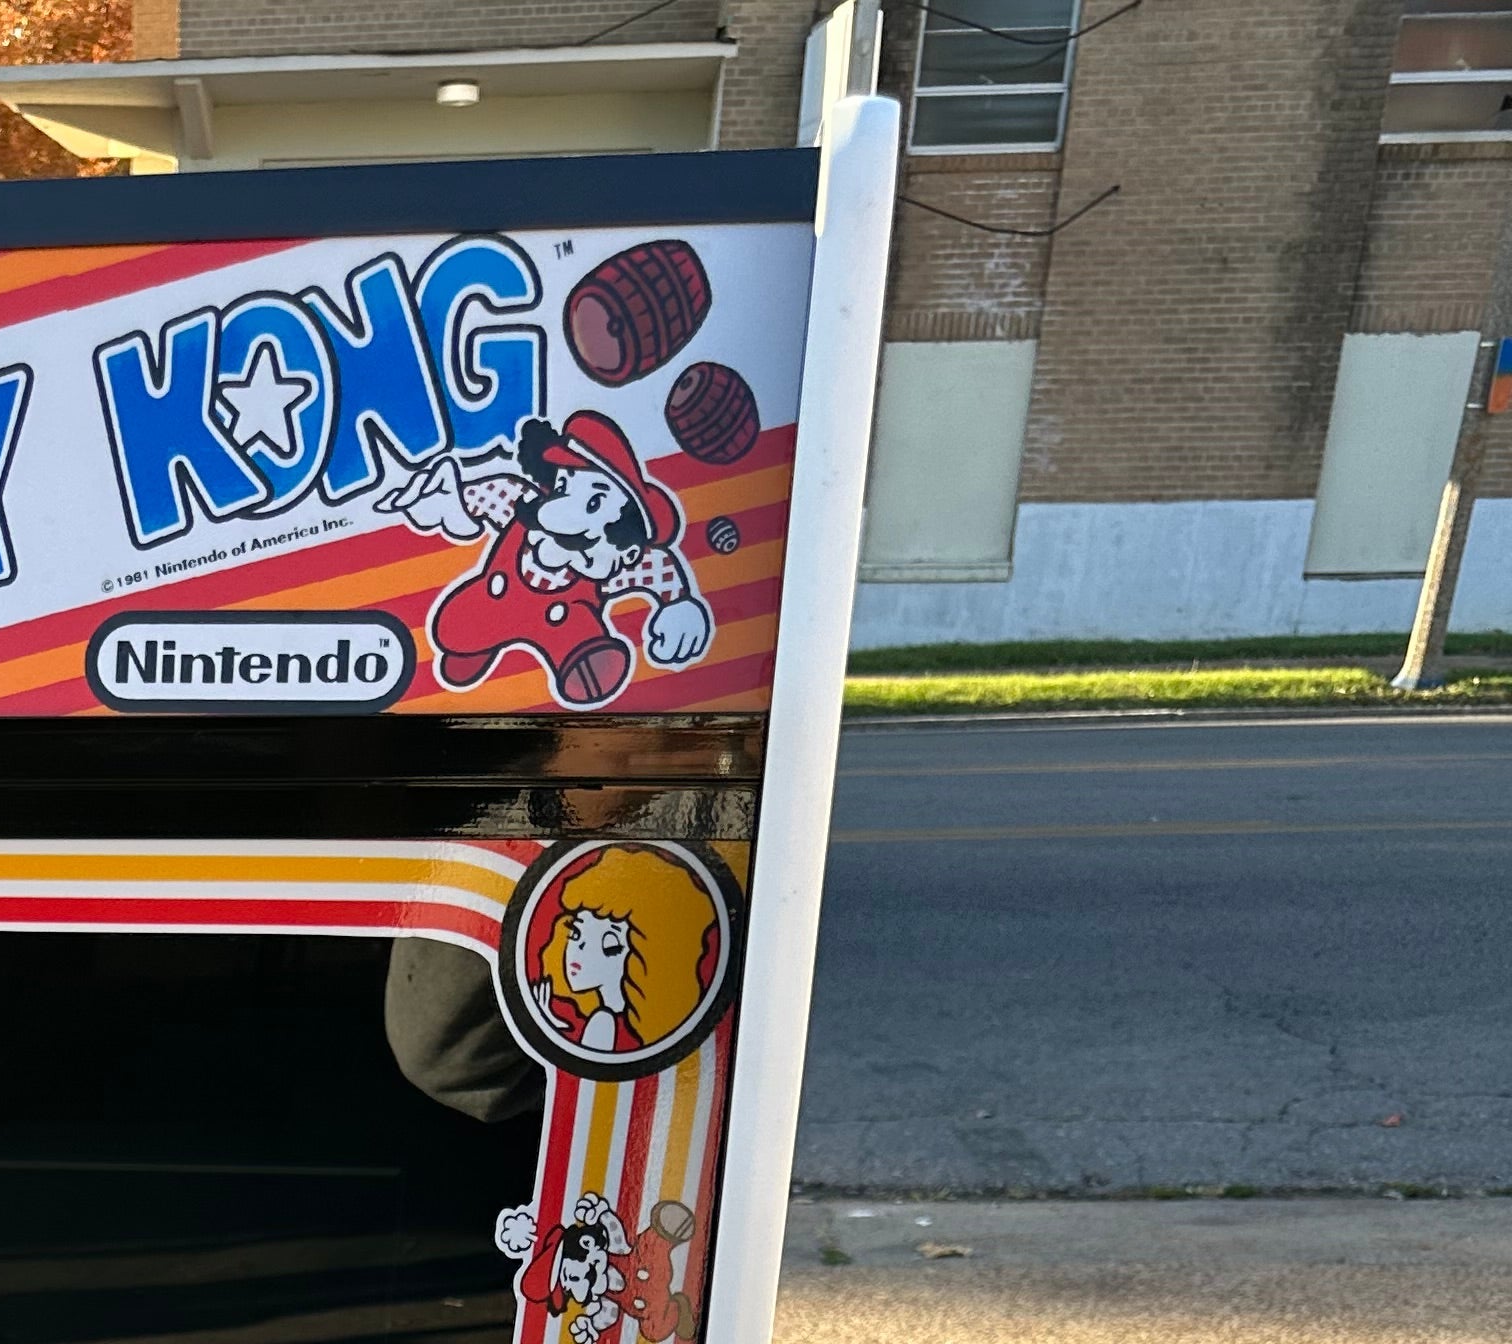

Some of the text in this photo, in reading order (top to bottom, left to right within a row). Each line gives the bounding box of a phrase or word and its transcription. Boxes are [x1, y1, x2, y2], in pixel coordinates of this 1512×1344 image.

[93, 232, 548, 551] KONG
[155, 549, 228, 579] Nintendo
[231, 541, 248, 557] of
[322, 517, 355, 538] Inc.
[114, 639, 389, 684] Nintendo
